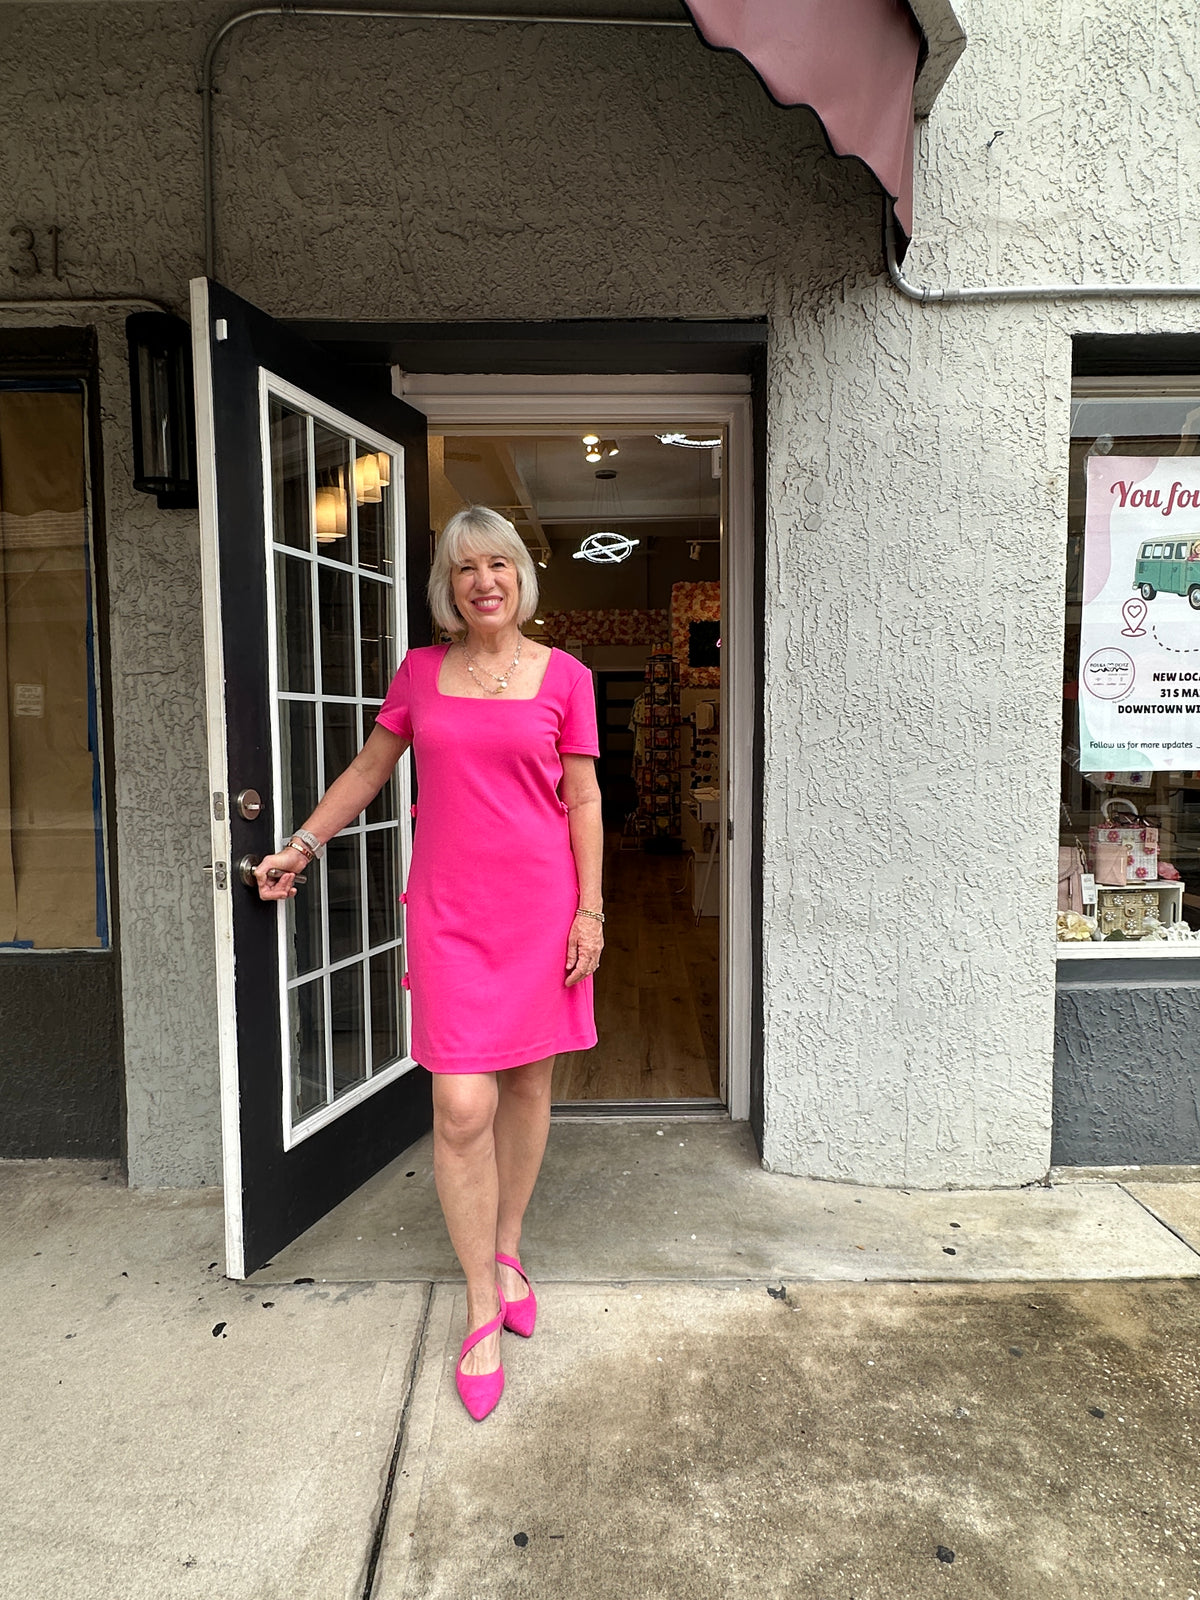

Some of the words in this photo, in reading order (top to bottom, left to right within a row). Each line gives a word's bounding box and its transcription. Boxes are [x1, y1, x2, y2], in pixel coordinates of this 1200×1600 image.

[9, 224, 62, 281] 31
[1110, 481, 1163, 508] You
[1153, 672, 1177, 682] NEW
[1179, 672, 1200, 682] LOC
[1160, 688, 1171, 698] 31
[1173, 688, 1179, 698] S
[1181, 688, 1200, 698] MA
[1118, 704, 1183, 714] DOWNTOWN
[1089, 741, 1115, 749] Follow
[1127, 740, 1139, 750] for
[1161, 741, 1193, 750] updates
